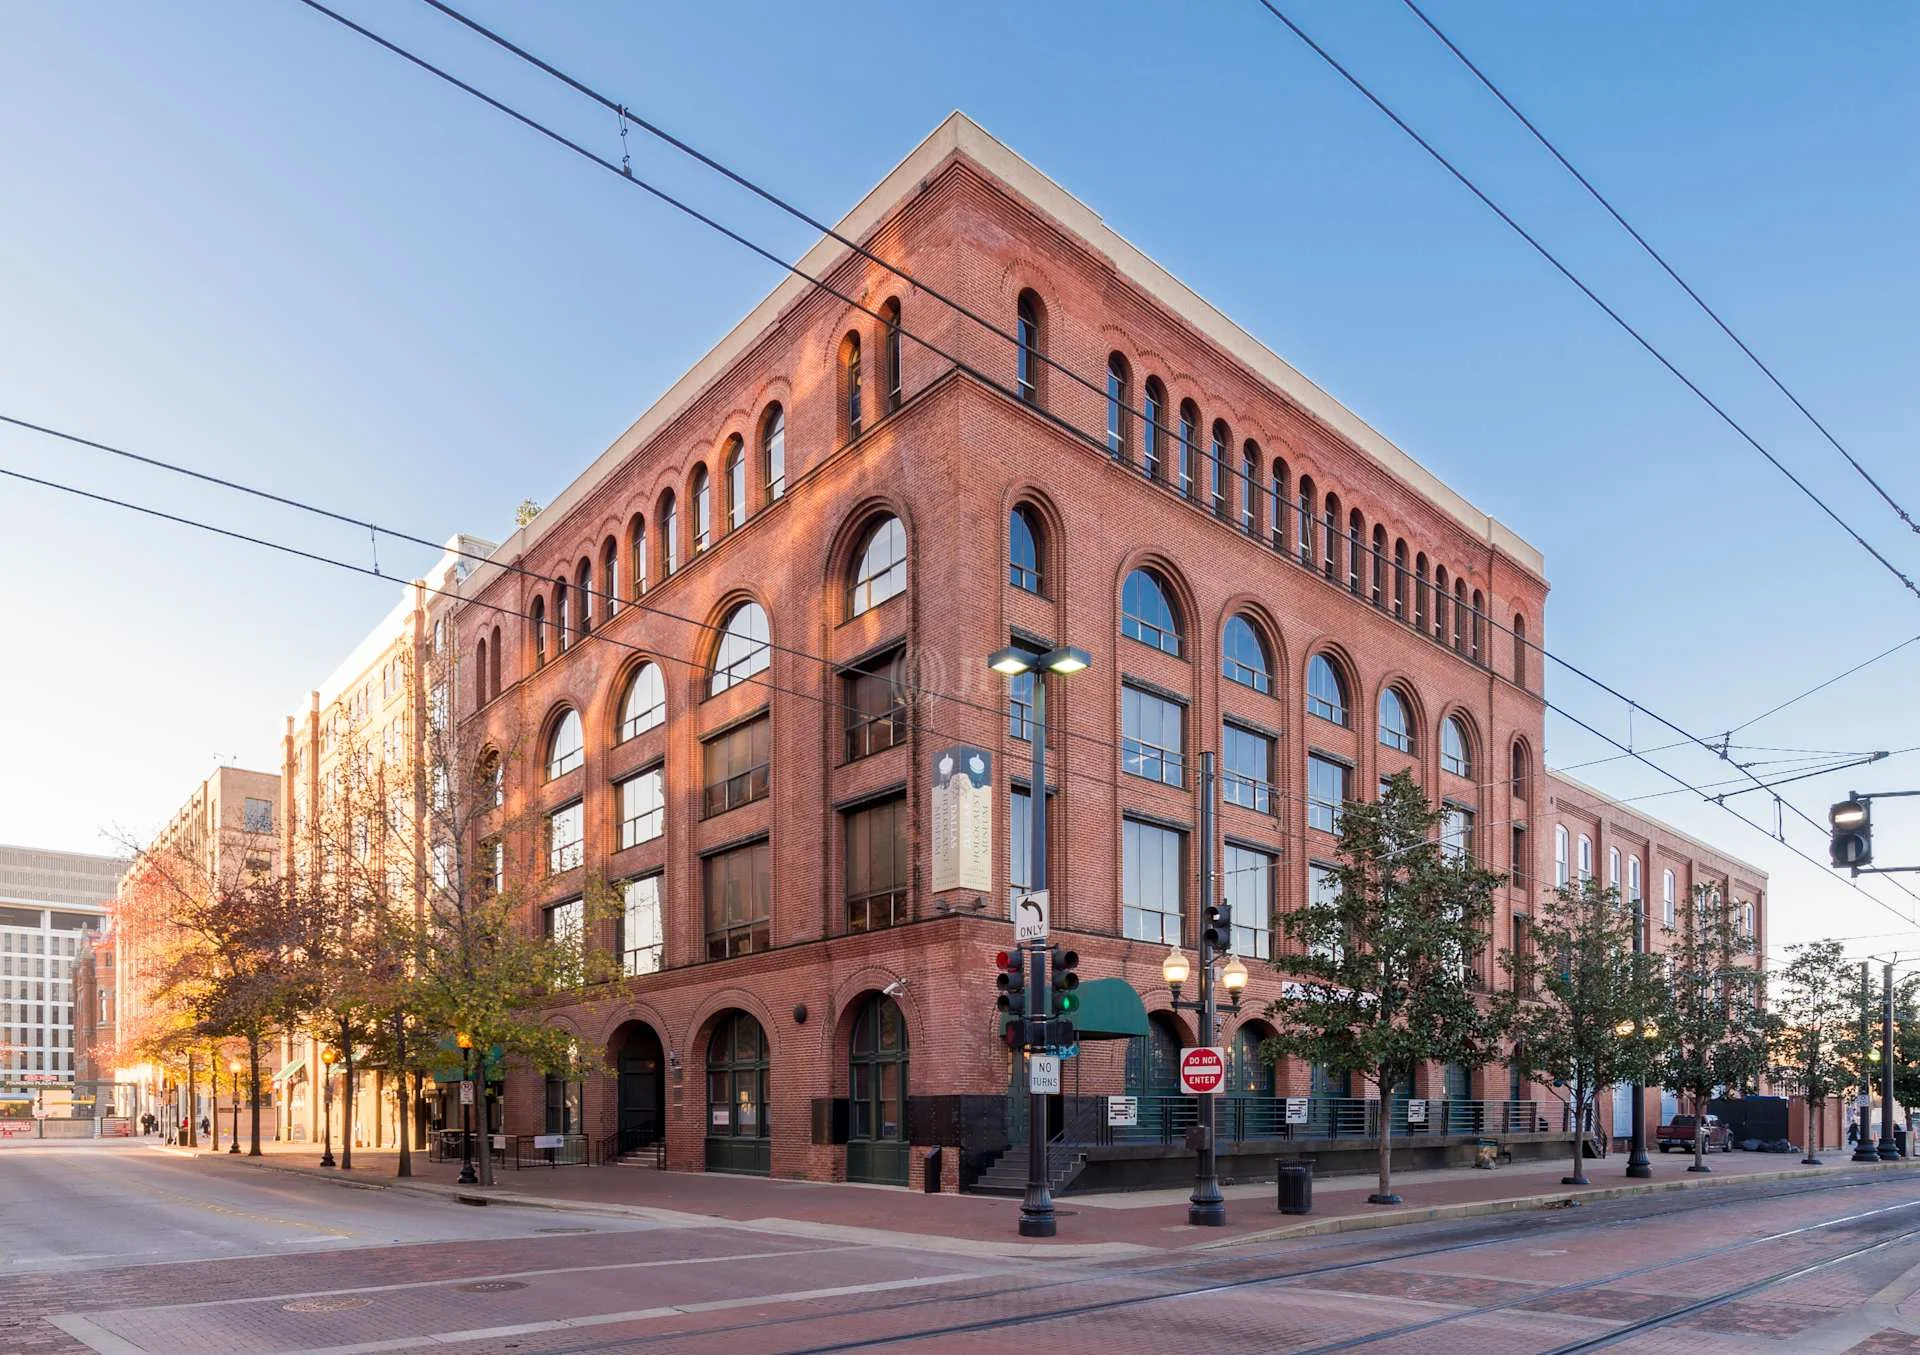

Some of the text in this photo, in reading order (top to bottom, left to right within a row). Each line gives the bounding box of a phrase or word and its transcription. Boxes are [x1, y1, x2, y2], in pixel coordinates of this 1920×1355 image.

[1020, 924, 1043, 938] ONLY
[1203, 1056, 1217, 1064] NOT
[1039, 1062, 1051, 1072] NO
[1033, 1077, 1057, 1087] TURNS
[1189, 1076, 1216, 1085] ENTER
